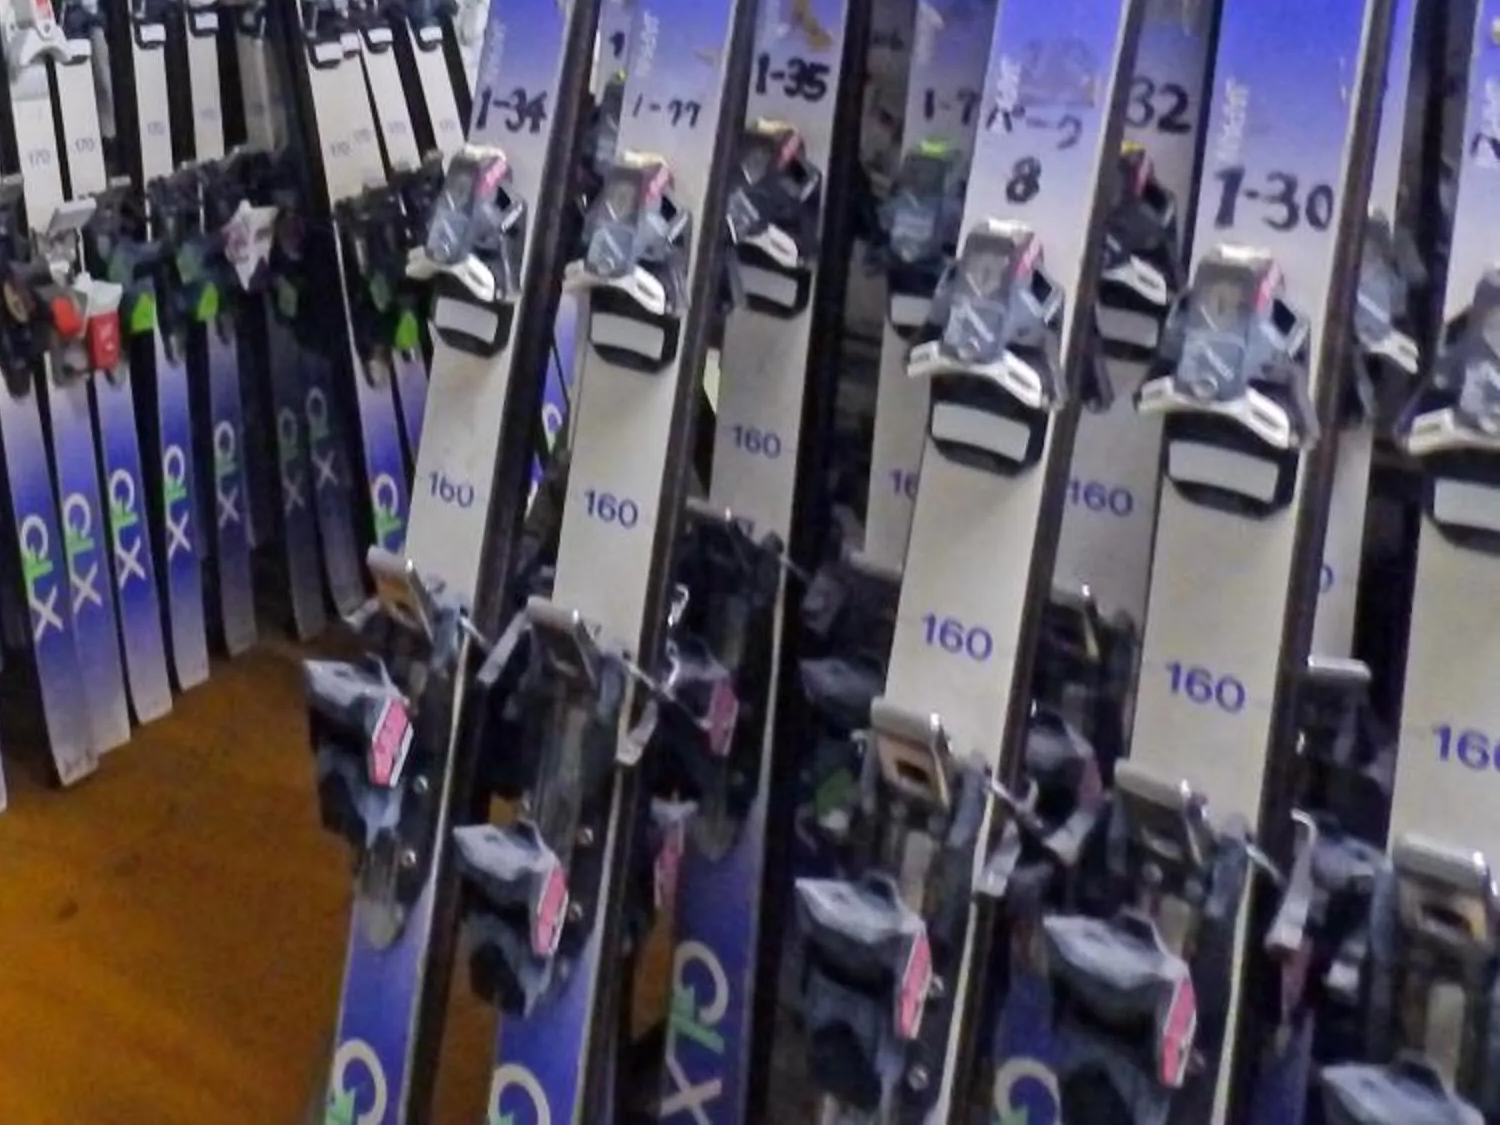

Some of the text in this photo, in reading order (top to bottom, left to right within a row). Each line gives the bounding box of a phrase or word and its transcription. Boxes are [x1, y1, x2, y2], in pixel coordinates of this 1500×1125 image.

[755, 52, 831, 102] 1-35
[476, 87, 547, 134] 1-34
[1006, 156, 1042, 205] 8
[1213, 166, 1334, 232] 1-30
[732, 424, 782, 460] 160
[426, 471, 476, 509] 160
[889, 468, 918, 500] 16
[1068, 479, 1134, 517] 160
[371, 474, 402, 548] GL
[583, 488, 639, 530] 160
[922, 612, 993, 662] 160
[1167, 659, 1246, 713] 160
